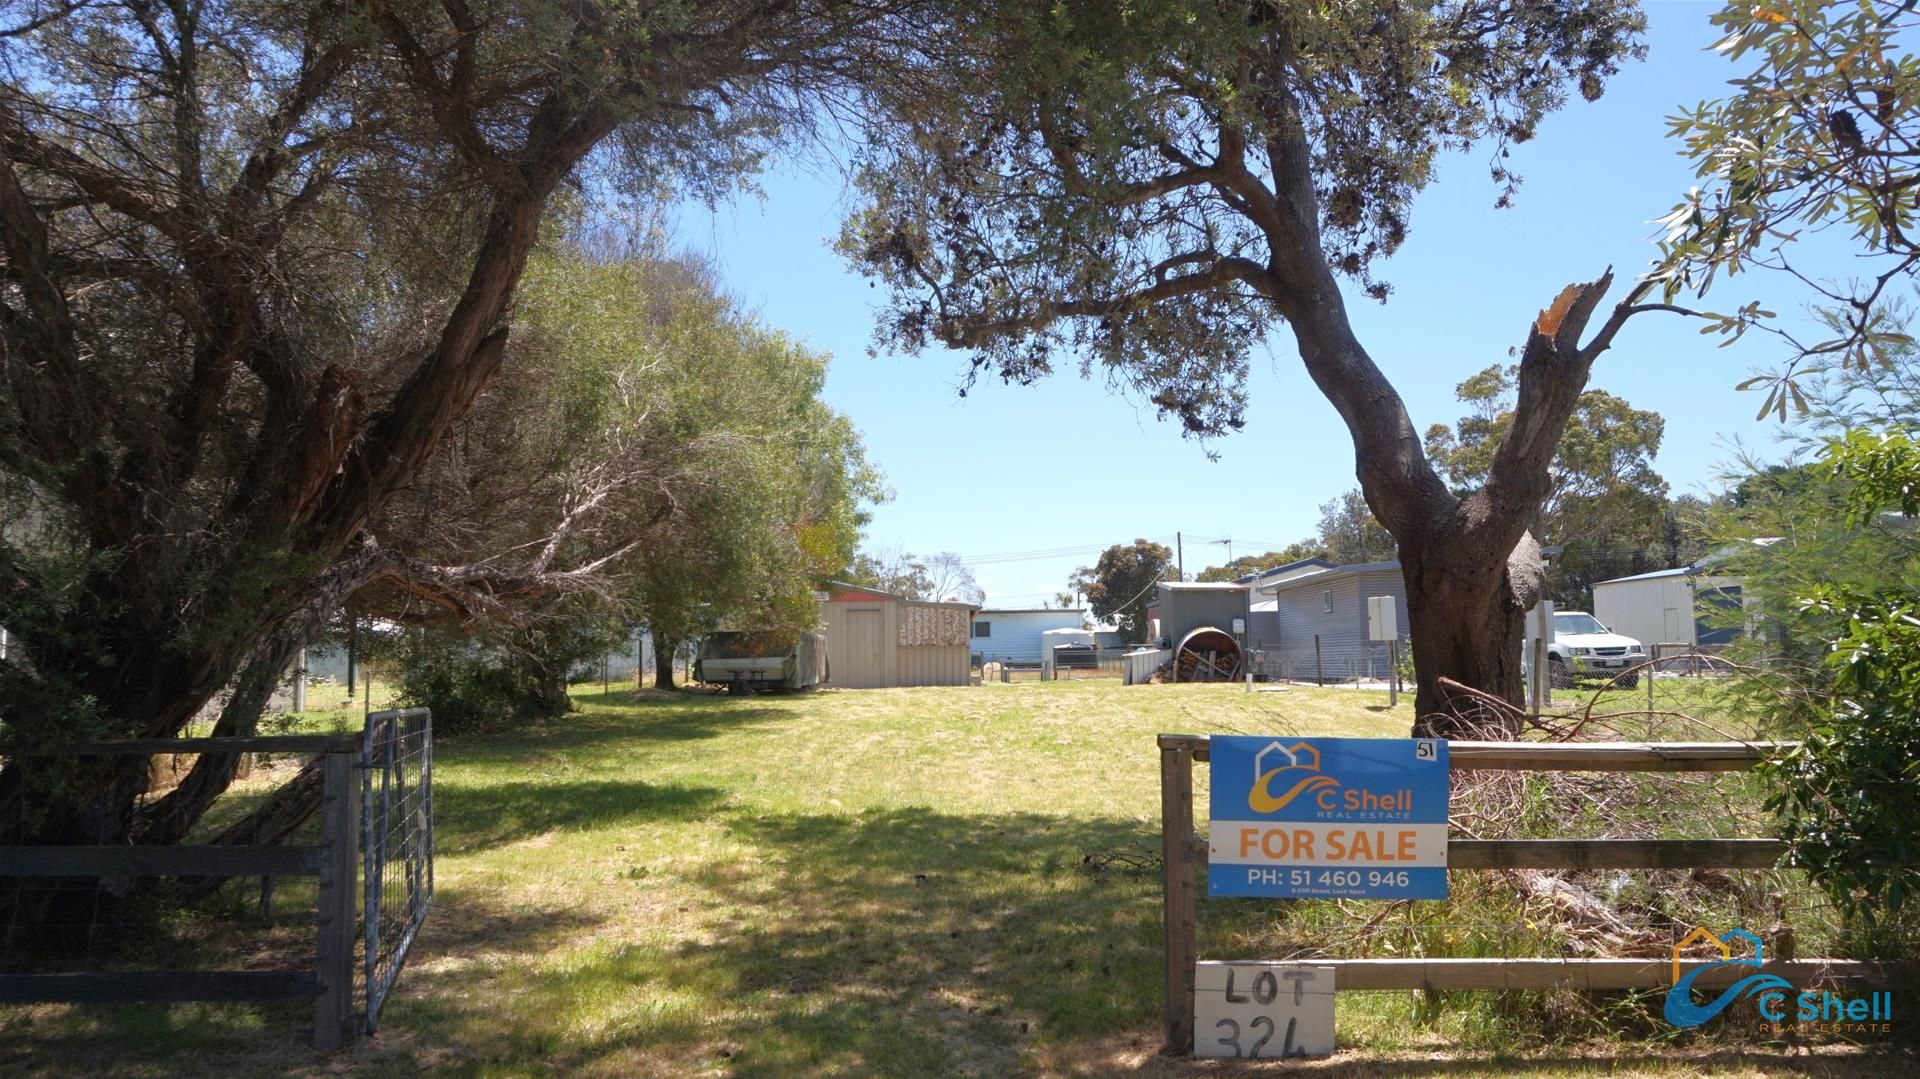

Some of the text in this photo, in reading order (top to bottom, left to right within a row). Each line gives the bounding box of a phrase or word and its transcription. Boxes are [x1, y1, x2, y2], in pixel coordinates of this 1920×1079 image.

[1418, 741, 1433, 757] 51
[1317, 789, 1412, 811] C Shell
[1317, 811, 1412, 820] REAL ESTATE
[1240, 828, 1417, 861] FOR SALE
[1248, 869, 1409, 887] PH: 51 460 946
[1225, 968, 1316, 1006] LOT
